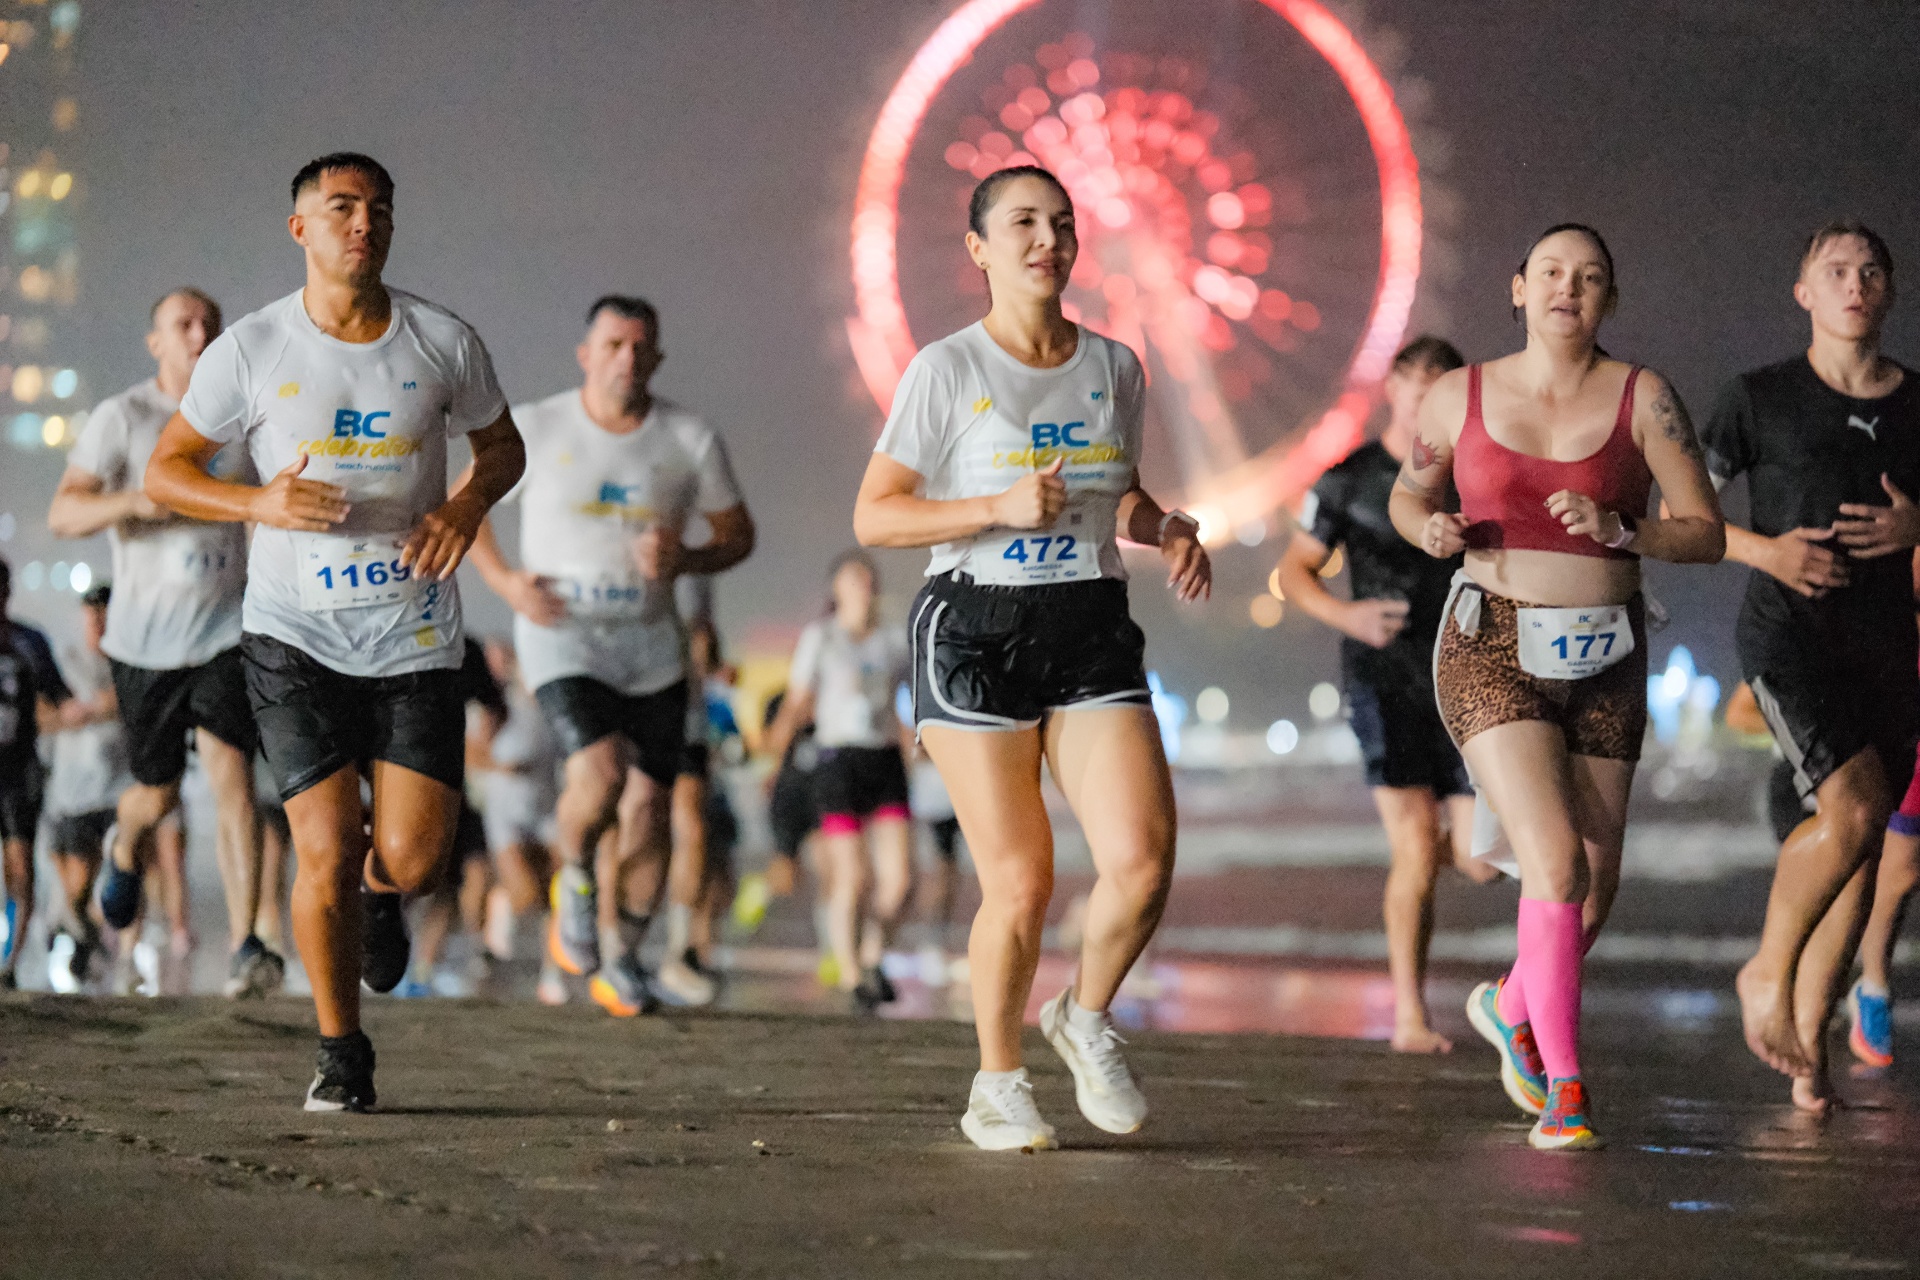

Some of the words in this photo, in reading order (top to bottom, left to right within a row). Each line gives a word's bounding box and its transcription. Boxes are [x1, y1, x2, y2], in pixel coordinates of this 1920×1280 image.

[333, 409, 391, 438] BC
[1032, 421, 1090, 448] BC
[297, 429, 424, 459] celebration
[335, 462, 363, 471] beach
[365, 463, 402, 473] running
[1003, 534, 1079, 564] 472
[316, 557, 411, 590] 1169
[1532, 621, 1543, 629] 5k
[1579, 614, 1593, 624] BC
[1551, 632, 1617, 660] 177
[1567, 659, 1602, 667] GABRIELA
